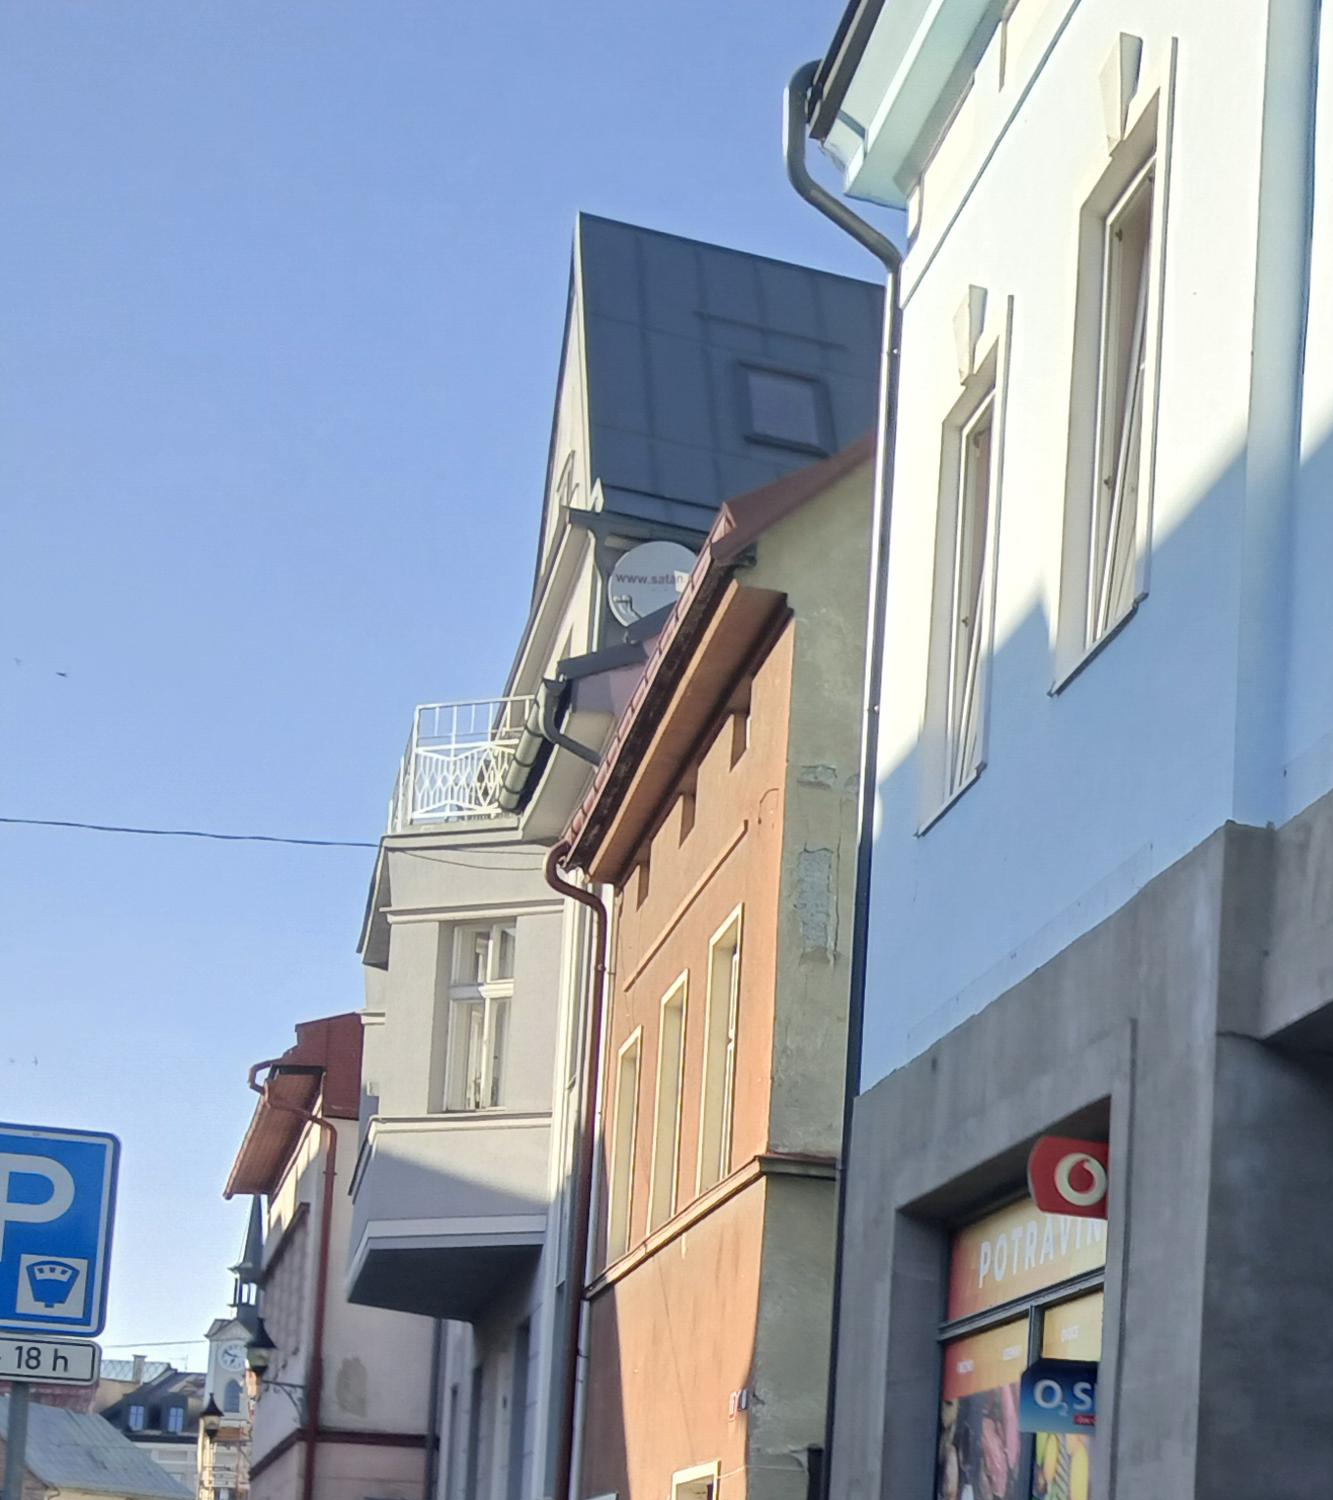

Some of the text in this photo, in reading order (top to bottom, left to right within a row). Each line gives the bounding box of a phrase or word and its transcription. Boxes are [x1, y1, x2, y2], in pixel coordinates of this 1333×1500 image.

[0, 1152, 76, 1262] P
[978, 1216, 1101, 1289] POTRAVIN
[15, 1346, 69, 1372] 18 h
